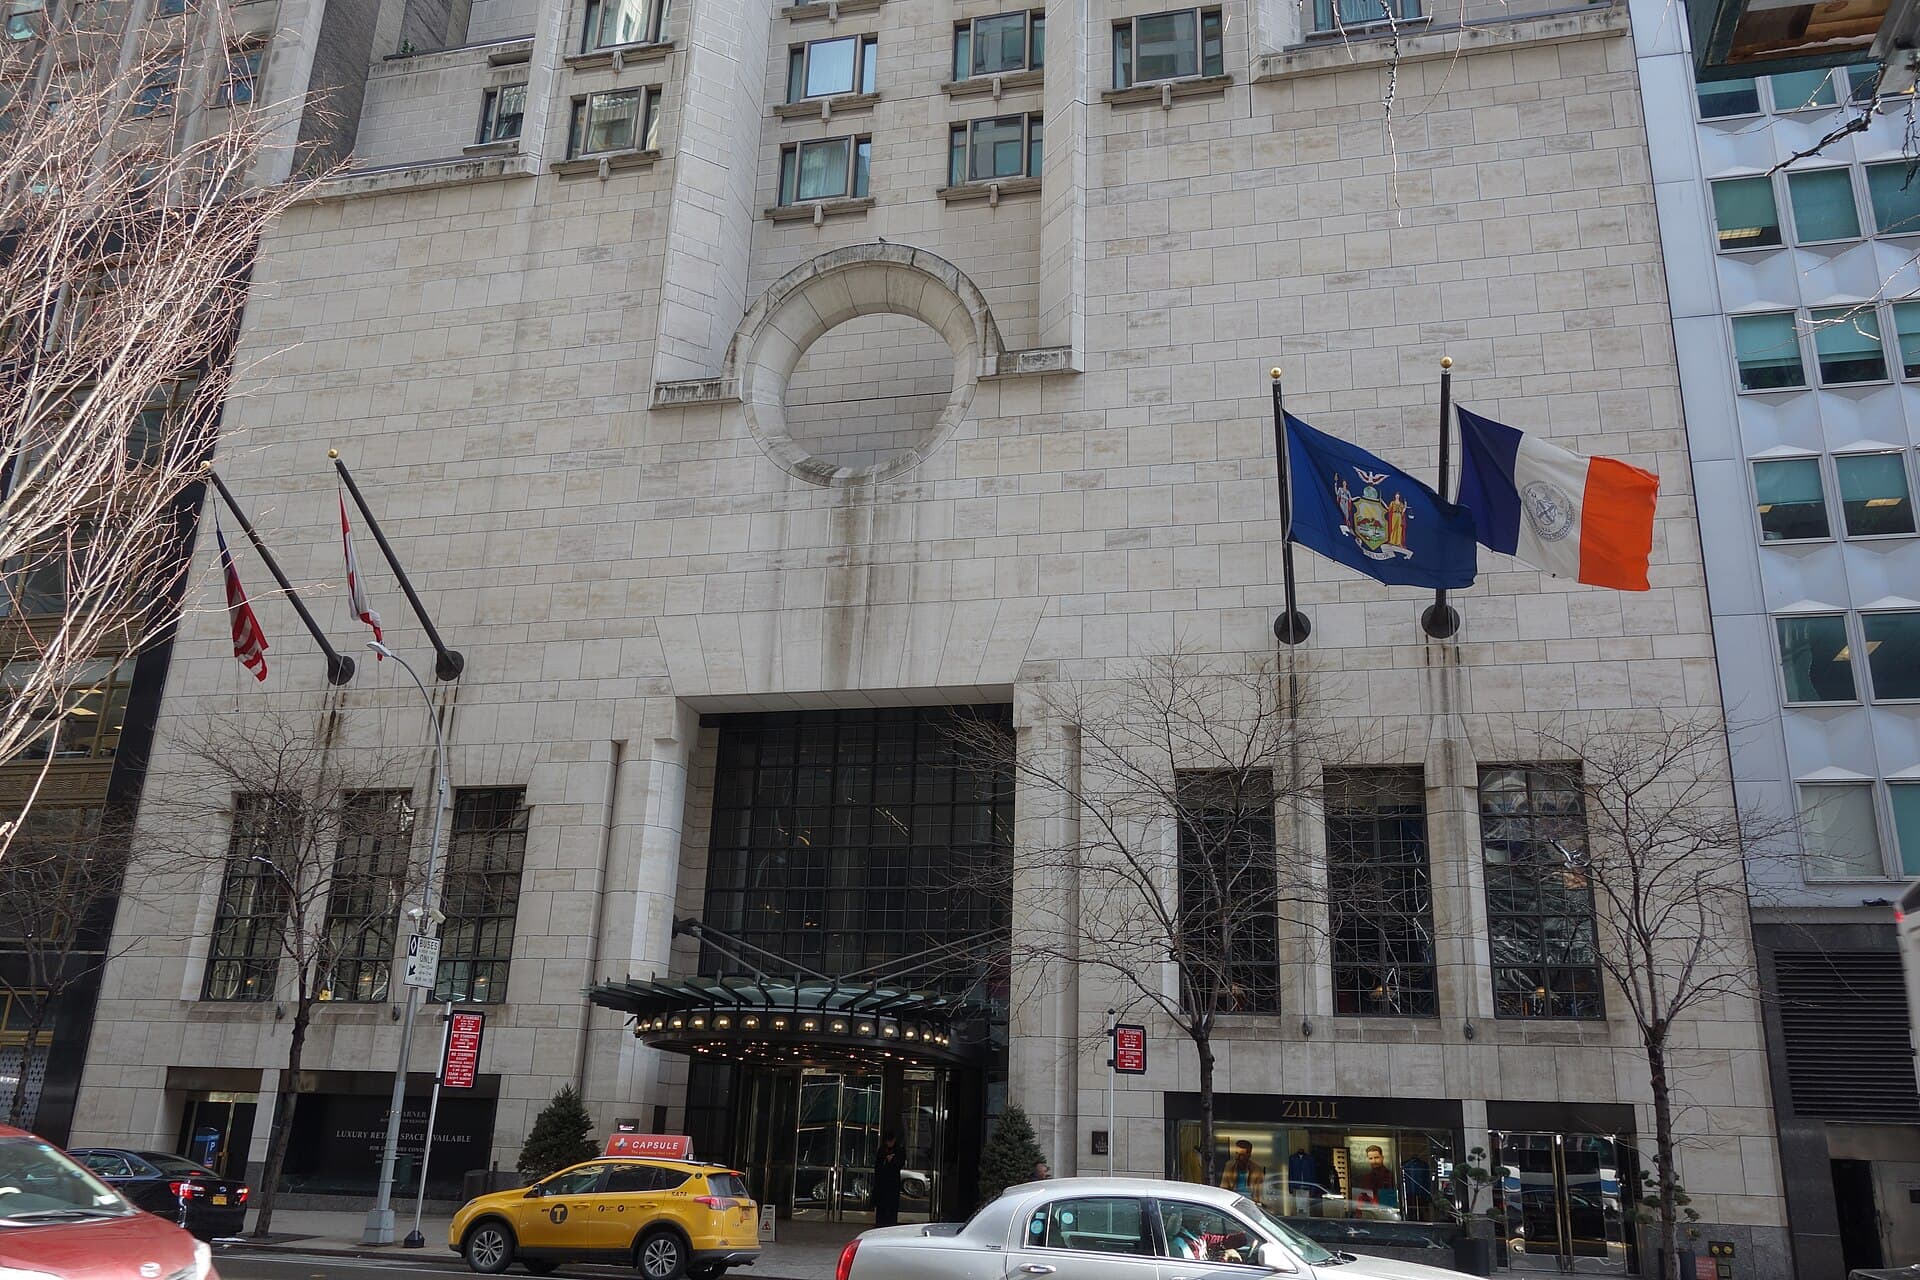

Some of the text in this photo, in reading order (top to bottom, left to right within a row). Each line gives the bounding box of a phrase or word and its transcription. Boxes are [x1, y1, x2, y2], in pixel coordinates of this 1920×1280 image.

[419, 938, 438, 950] BUSES
[420, 954, 433, 964] ONLY
[1282, 1100, 1337, 1119] ZILLI
[336, 1130, 368, 1139] LUXURY
[400, 1133, 425, 1141] SPACE
[430, 1134, 472, 1142] VAILABLE
[632, 1141, 679, 1150] CAPSULE
